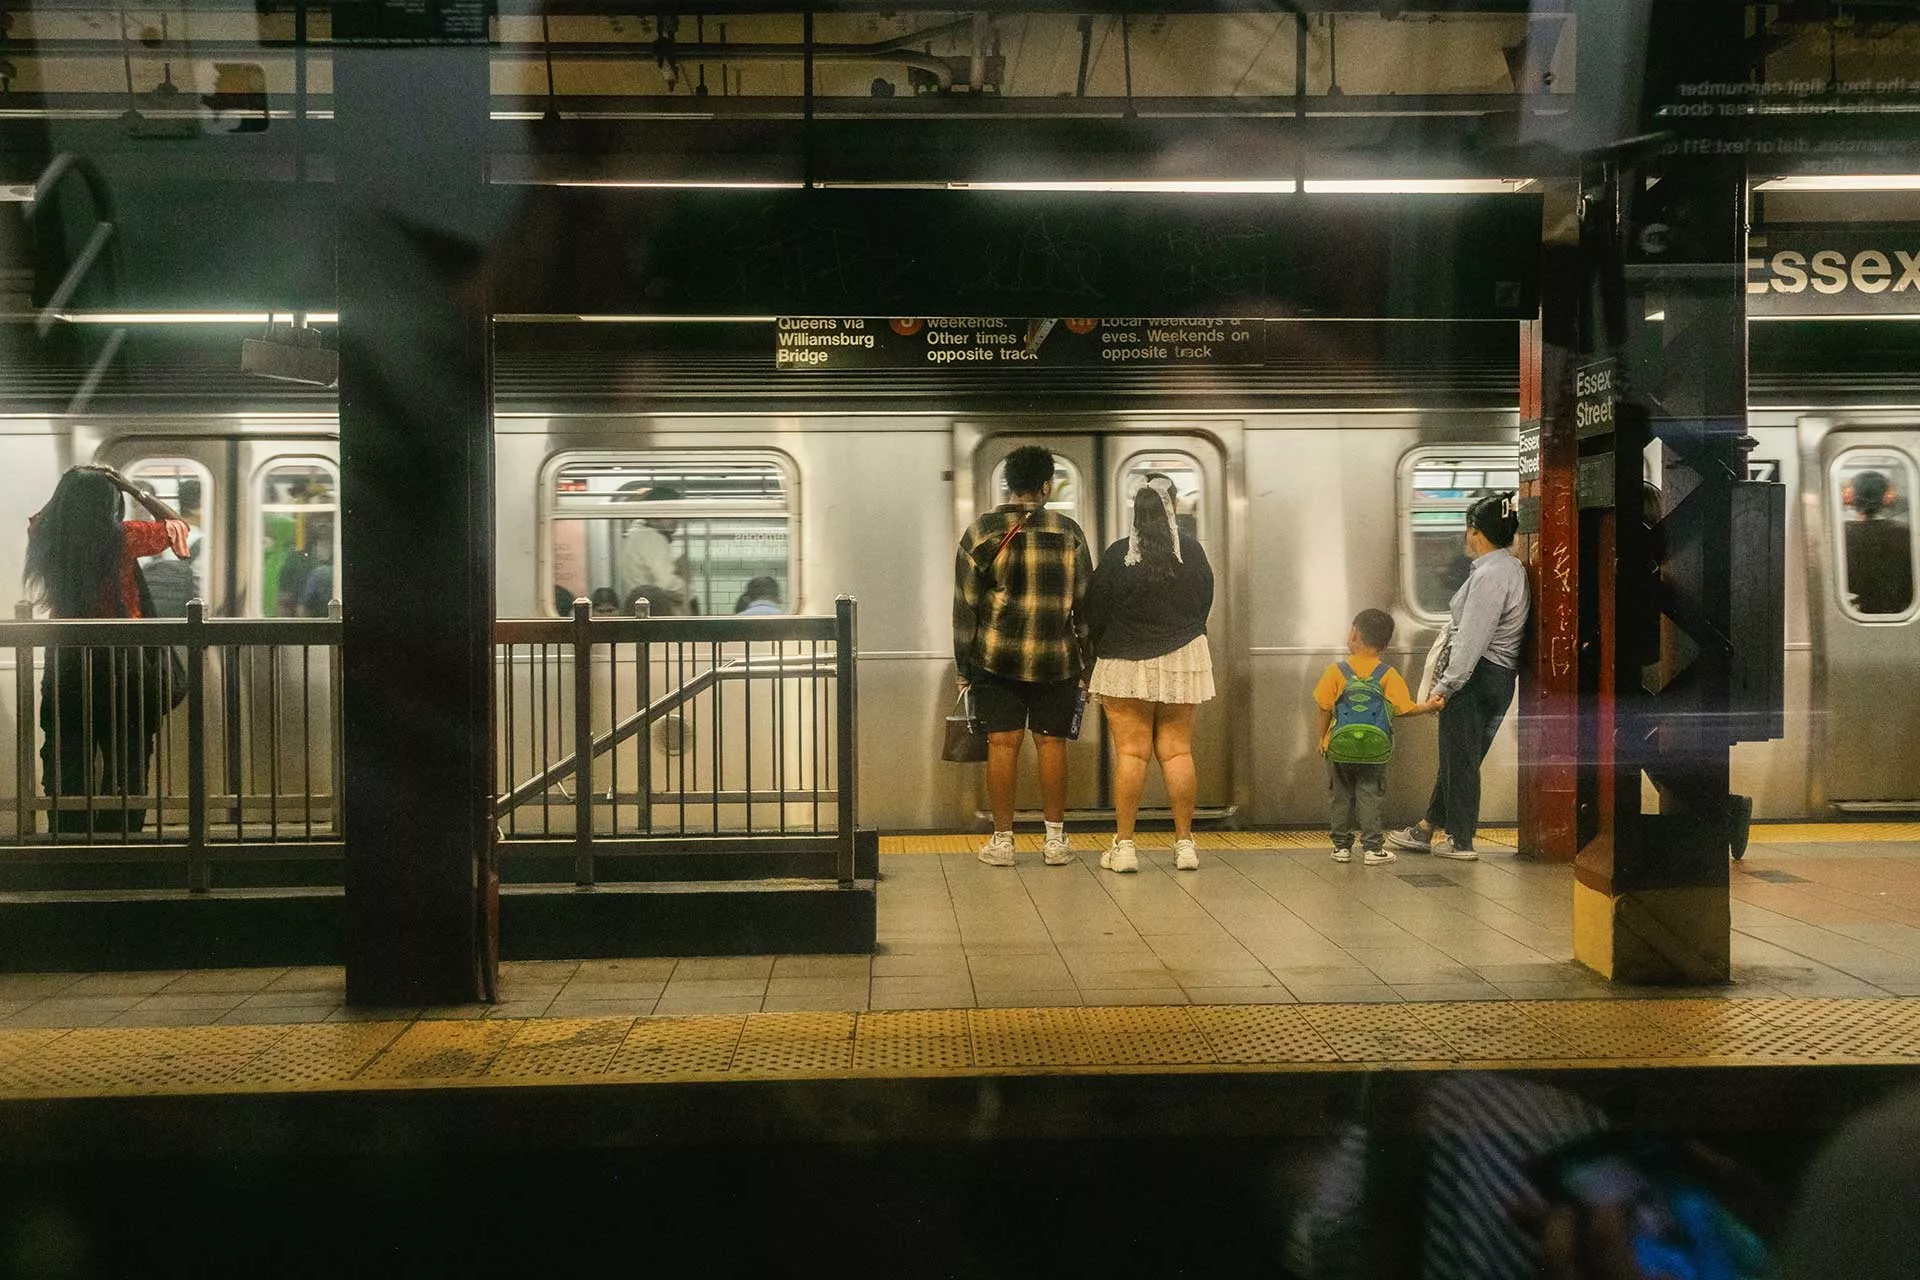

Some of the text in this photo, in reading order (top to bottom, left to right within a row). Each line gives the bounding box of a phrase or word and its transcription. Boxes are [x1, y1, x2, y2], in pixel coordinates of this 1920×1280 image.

[779, 317, 864, 330] Queens via
[778, 332, 875, 348] Williamsburg
[926, 331, 969, 345] Other
[976, 331, 1017, 344] times
[1101, 329, 1250, 343] eves. Weekends on
[778, 349, 828, 365] Bridge
[926, 347, 994, 363] opposite
[1101, 345, 1212, 361] opposite track
[1576, 369, 1612, 398] Essex
[1576, 395, 1613, 428] Street
